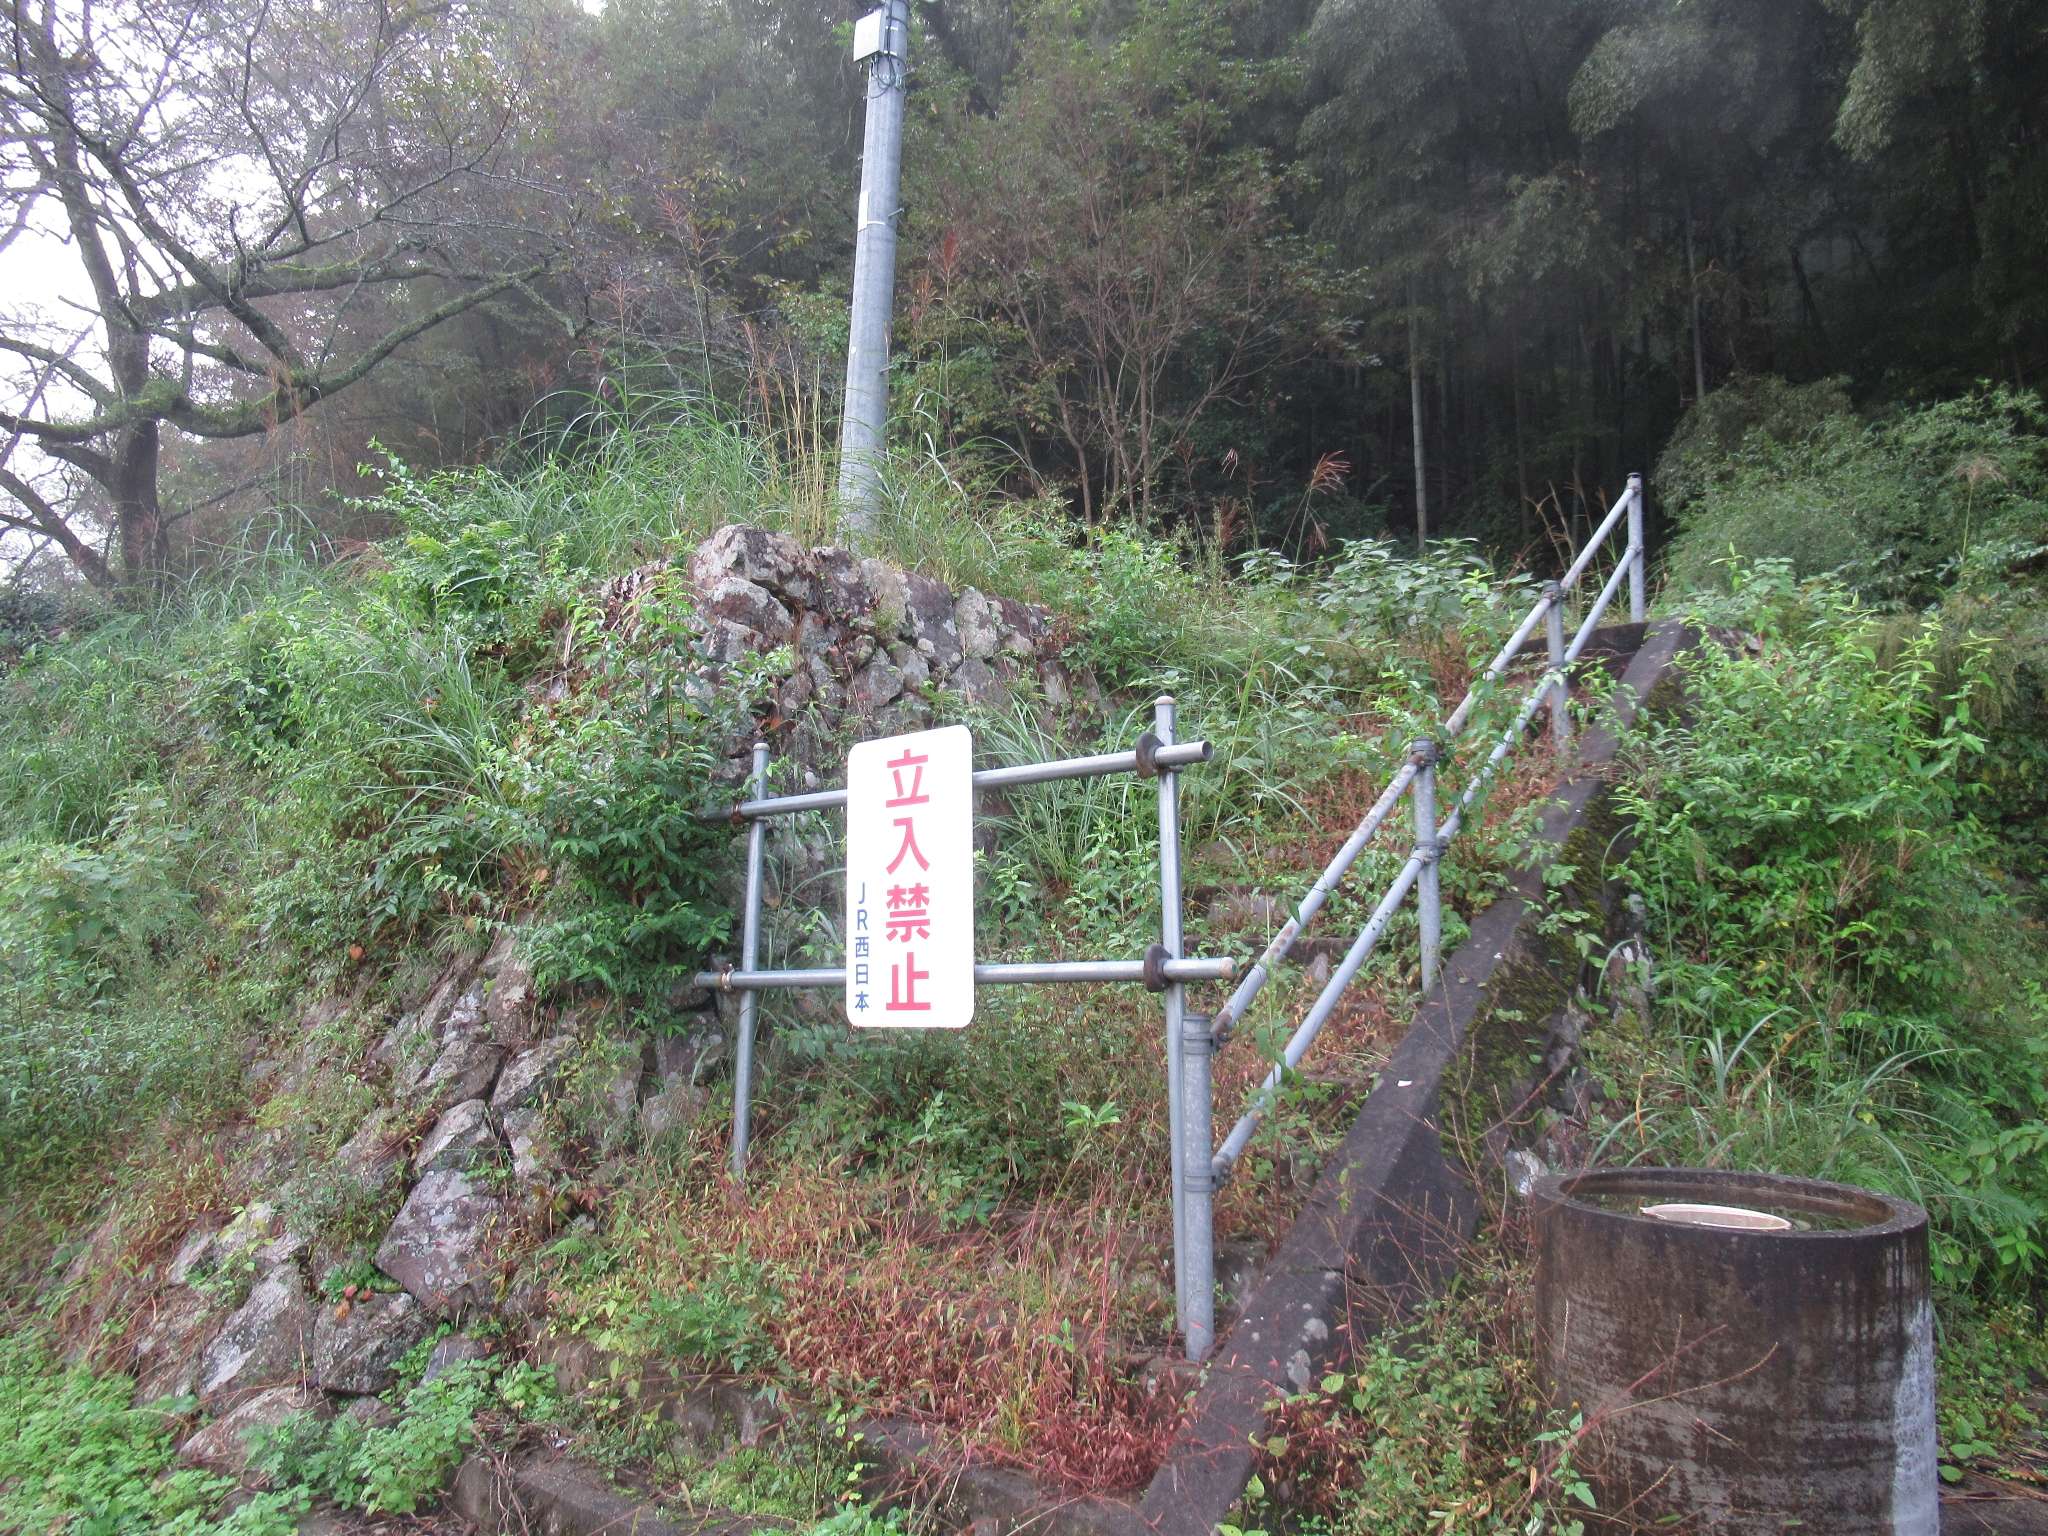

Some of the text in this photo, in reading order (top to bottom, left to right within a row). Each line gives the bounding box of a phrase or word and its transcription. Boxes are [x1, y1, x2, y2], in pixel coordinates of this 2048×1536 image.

[854, 881, 870, 1013] JR西日本
[885, 748, 931, 1011] 立入禁止
